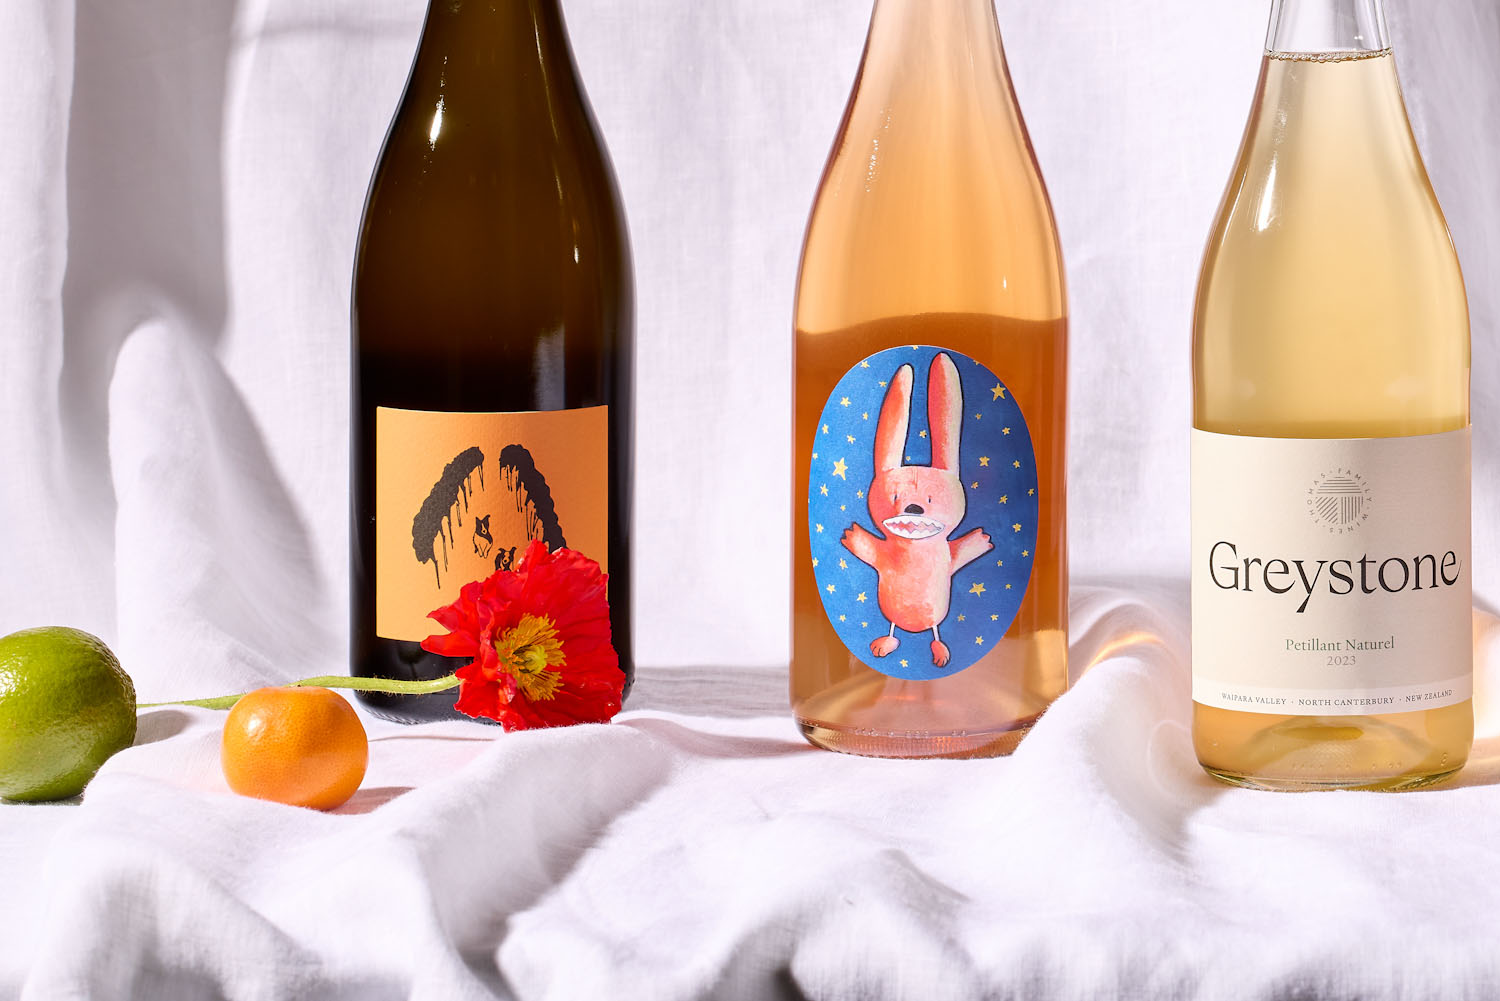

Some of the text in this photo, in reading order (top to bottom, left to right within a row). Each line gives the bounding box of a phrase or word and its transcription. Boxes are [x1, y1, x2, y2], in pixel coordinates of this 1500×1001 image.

[1337, 467, 1373, 502] FAMILY
[1329, 513, 1369, 534] WINES
[1209, 541, 1462, 614] Greystone
[1285, 636, 1395, 651] Petillant Naturel
[1326, 655, 1357, 666] 2023
[1221, 689, 1453, 706] WAIPARA VALLEY NORTH CANTERBURY NEW ZEALAND
